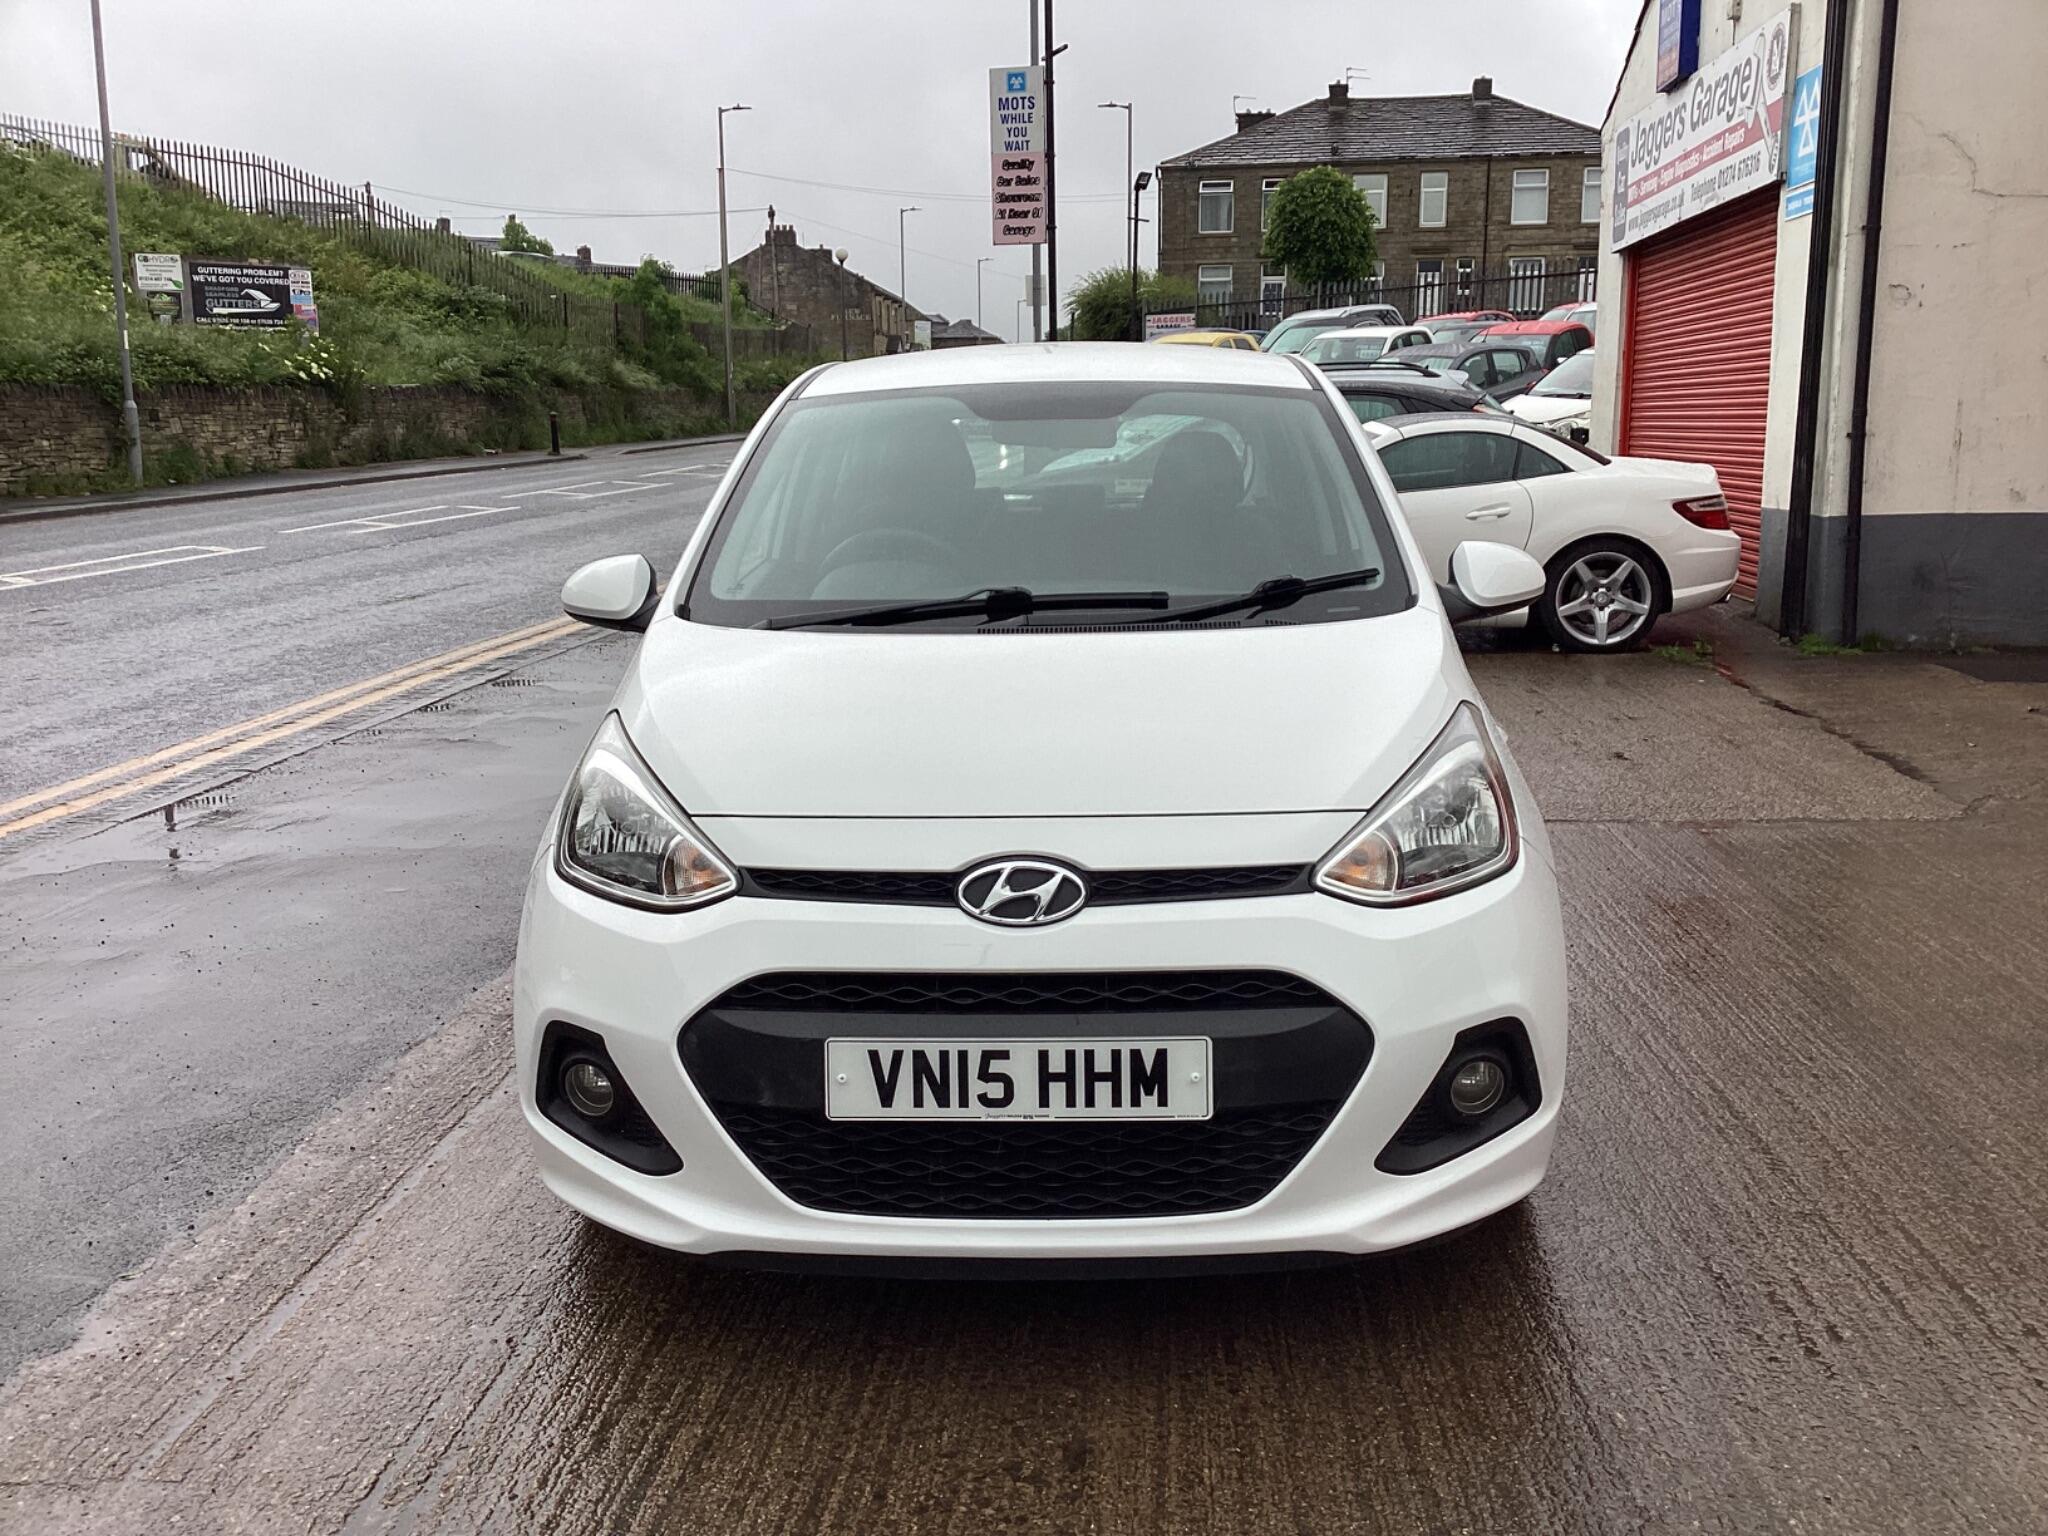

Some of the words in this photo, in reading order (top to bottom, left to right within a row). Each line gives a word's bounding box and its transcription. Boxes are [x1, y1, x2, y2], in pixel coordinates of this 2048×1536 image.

[998, 96, 1036, 111] MOTS
[1000, 113, 1034, 125] WHILE
[1631, 99, 1686, 171] Jaggers
[1690, 56, 1753, 132] Garage
[1006, 126, 1028, 138] YOU
[1004, 140, 1030, 152] WAIT
[1717, 161, 1737, 190] 01274
[197, 267, 242, 276] GUTTERING
[243, 268, 284, 278] PROBLEM?
[192, 274, 218, 283] WE'VE
[218, 276, 235, 284] GOT
[254, 277, 290, 286] COVERED
[205, 298, 261, 309] GUTTERS
[867, 1048, 1015, 1109] VN15
[1037, 1047, 1168, 1109] HHM
